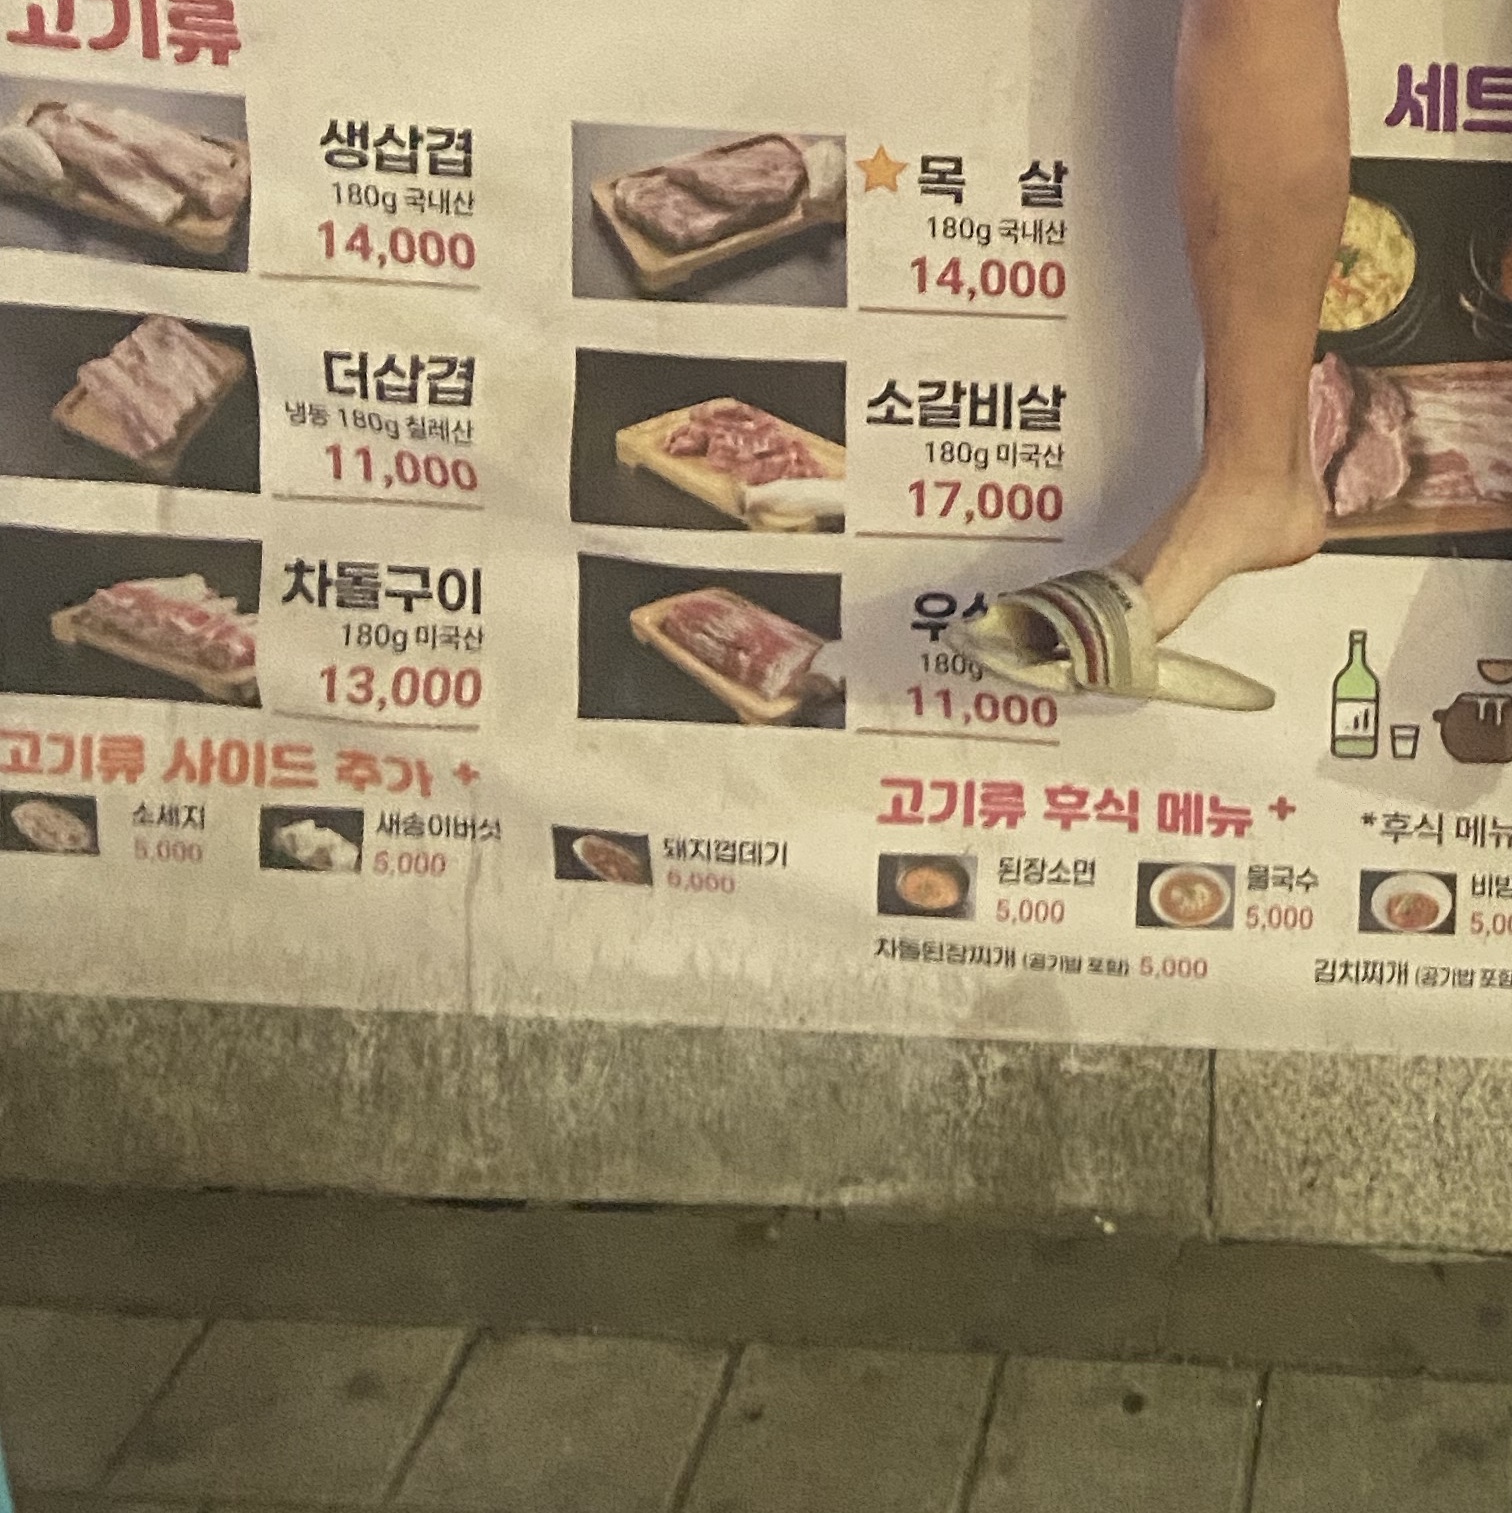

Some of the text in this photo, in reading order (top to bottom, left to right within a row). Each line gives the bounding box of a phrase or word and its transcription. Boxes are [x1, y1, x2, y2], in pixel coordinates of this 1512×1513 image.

[332, 182, 475, 216] 180g 국내산
[317, 220, 476, 271] 14,000
[927, 216, 1067, 246] 180g 국내산
[910, 255, 1066, 301] 14,000
[285, 400, 475, 443] 냉동 180g 칠레산
[866, 379, 1067, 431] 소갈비살
[326, 443, 478, 491] 11,000
[925, 441, 1065, 471] 180g 미국산
[909, 479, 1063, 524] 17,000
[281, 558, 482, 614] 차돌구이
[910, 591, 989, 642] 우
[341, 624, 484, 653] 180g 미국산
[921, 654, 983, 681] 180g
[320, 664, 482, 711] 13,000
[907, 685, 1058, 728] 11,000
[0, 729, 433, 797] 고기류 사이드 추가
[132, 801, 206, 831] 소세지
[376, 810, 502, 840] 새송이버섯
[876, 777, 1254, 839] 고기류 후식 메뉴
[663, 837, 789, 869] 돼지껍데기
[997, 856, 1097, 888] 된장소면
[1246, 864, 1319, 893] 물국수
[995, 899, 1065, 925] 5,000
[1245, 905, 1314, 931] 5,000
[874, 938, 1016, 969] 차돌된장찌개
[1140, 956, 1209, 979] 5,000
[1314, 958, 1409, 985] 김치찌개
